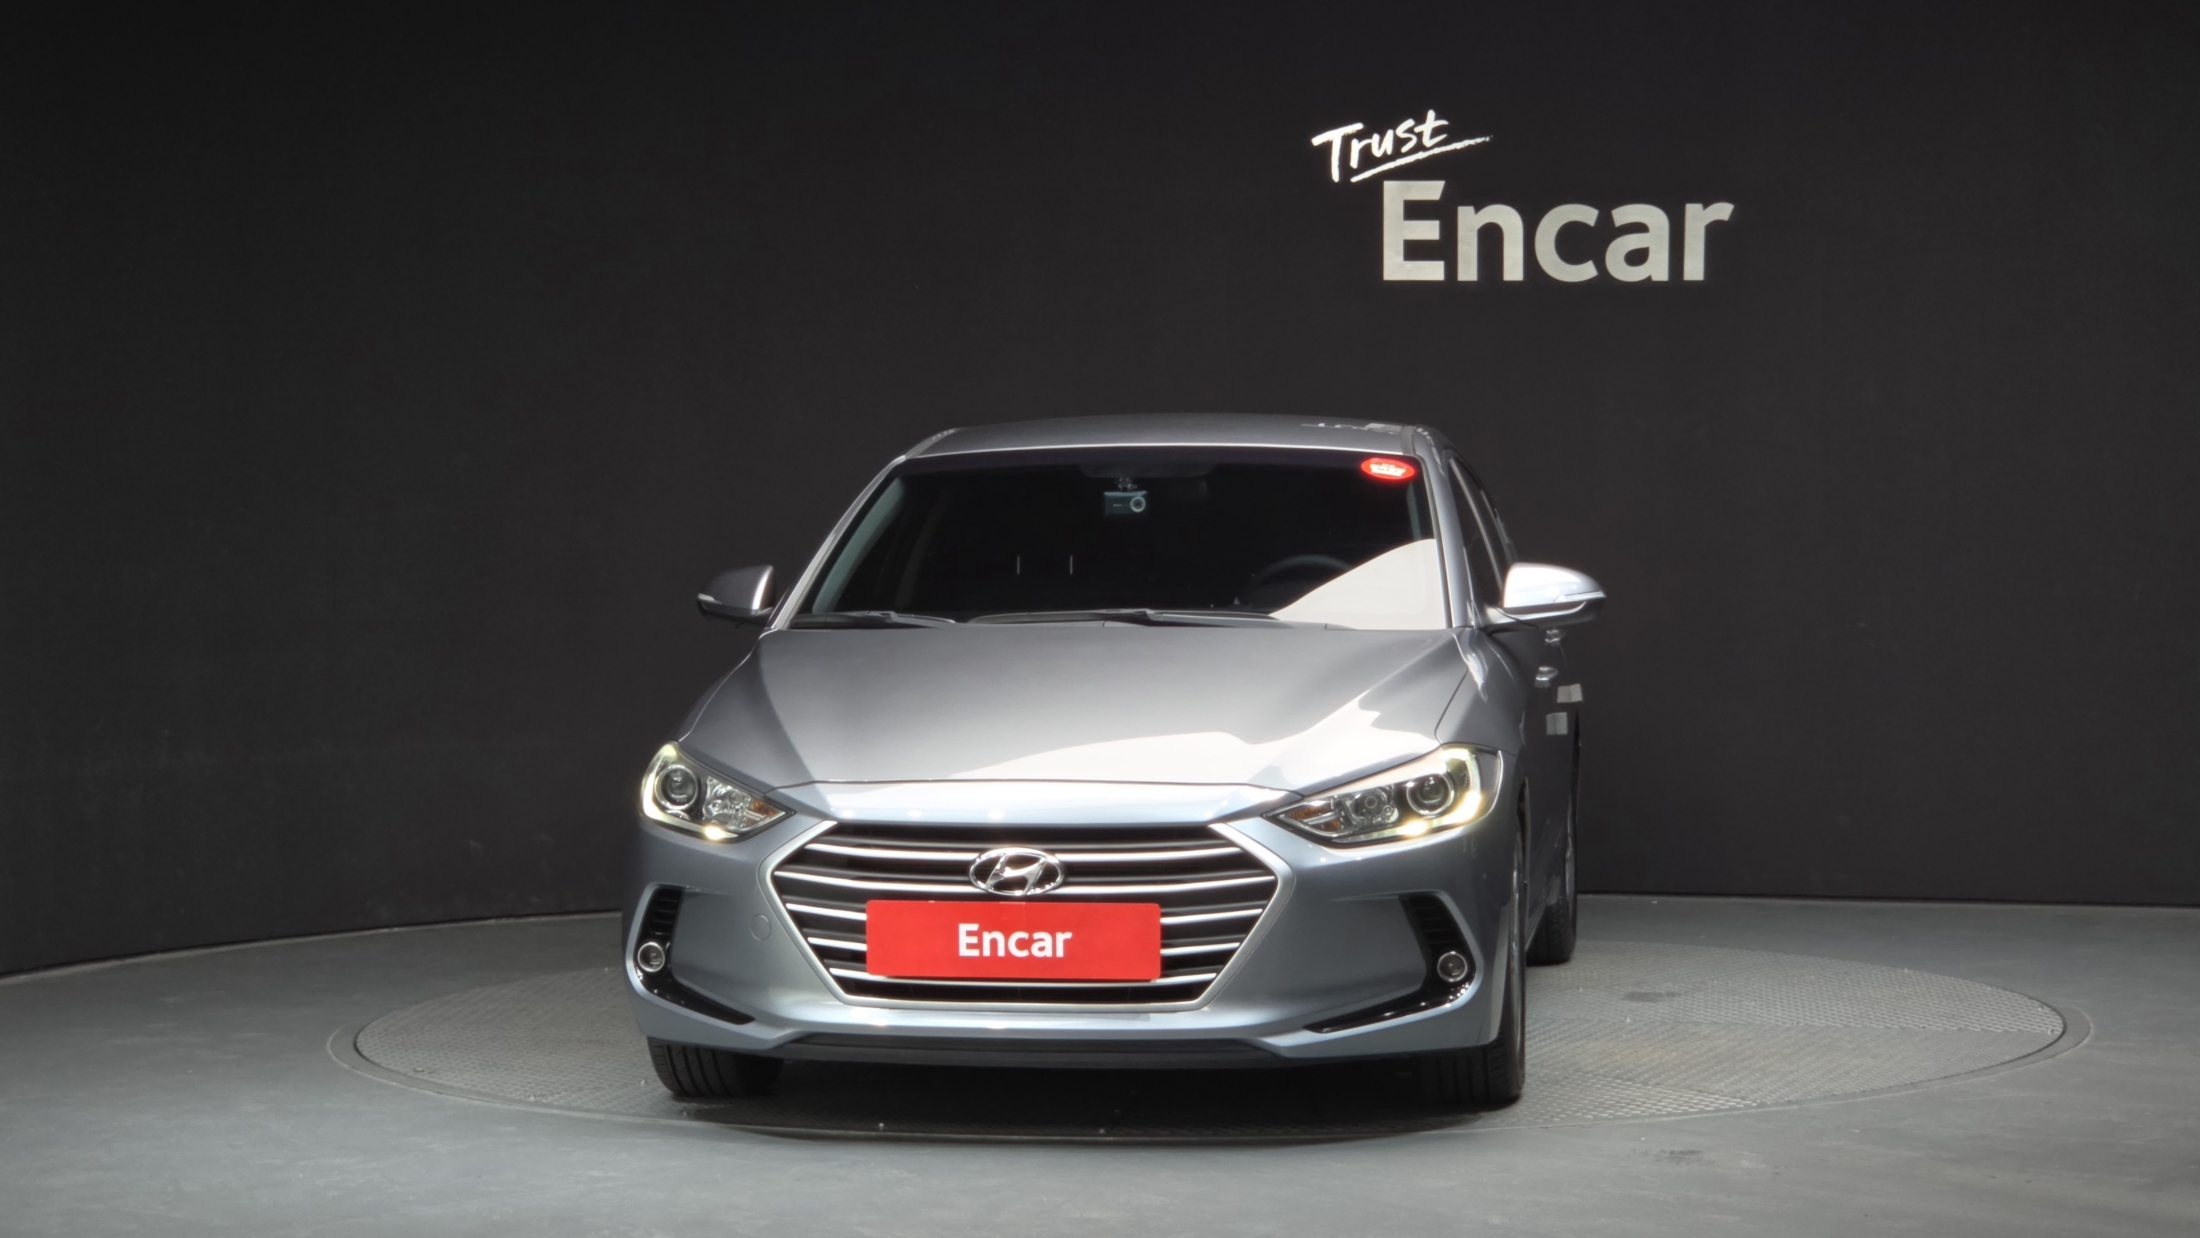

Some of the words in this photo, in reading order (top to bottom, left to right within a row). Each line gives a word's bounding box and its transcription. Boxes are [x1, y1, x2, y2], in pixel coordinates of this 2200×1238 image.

[1310, 108, 1452, 183] Trust
[1382, 179, 1735, 283] Encar
[957, 922, 1073, 958] Encar
